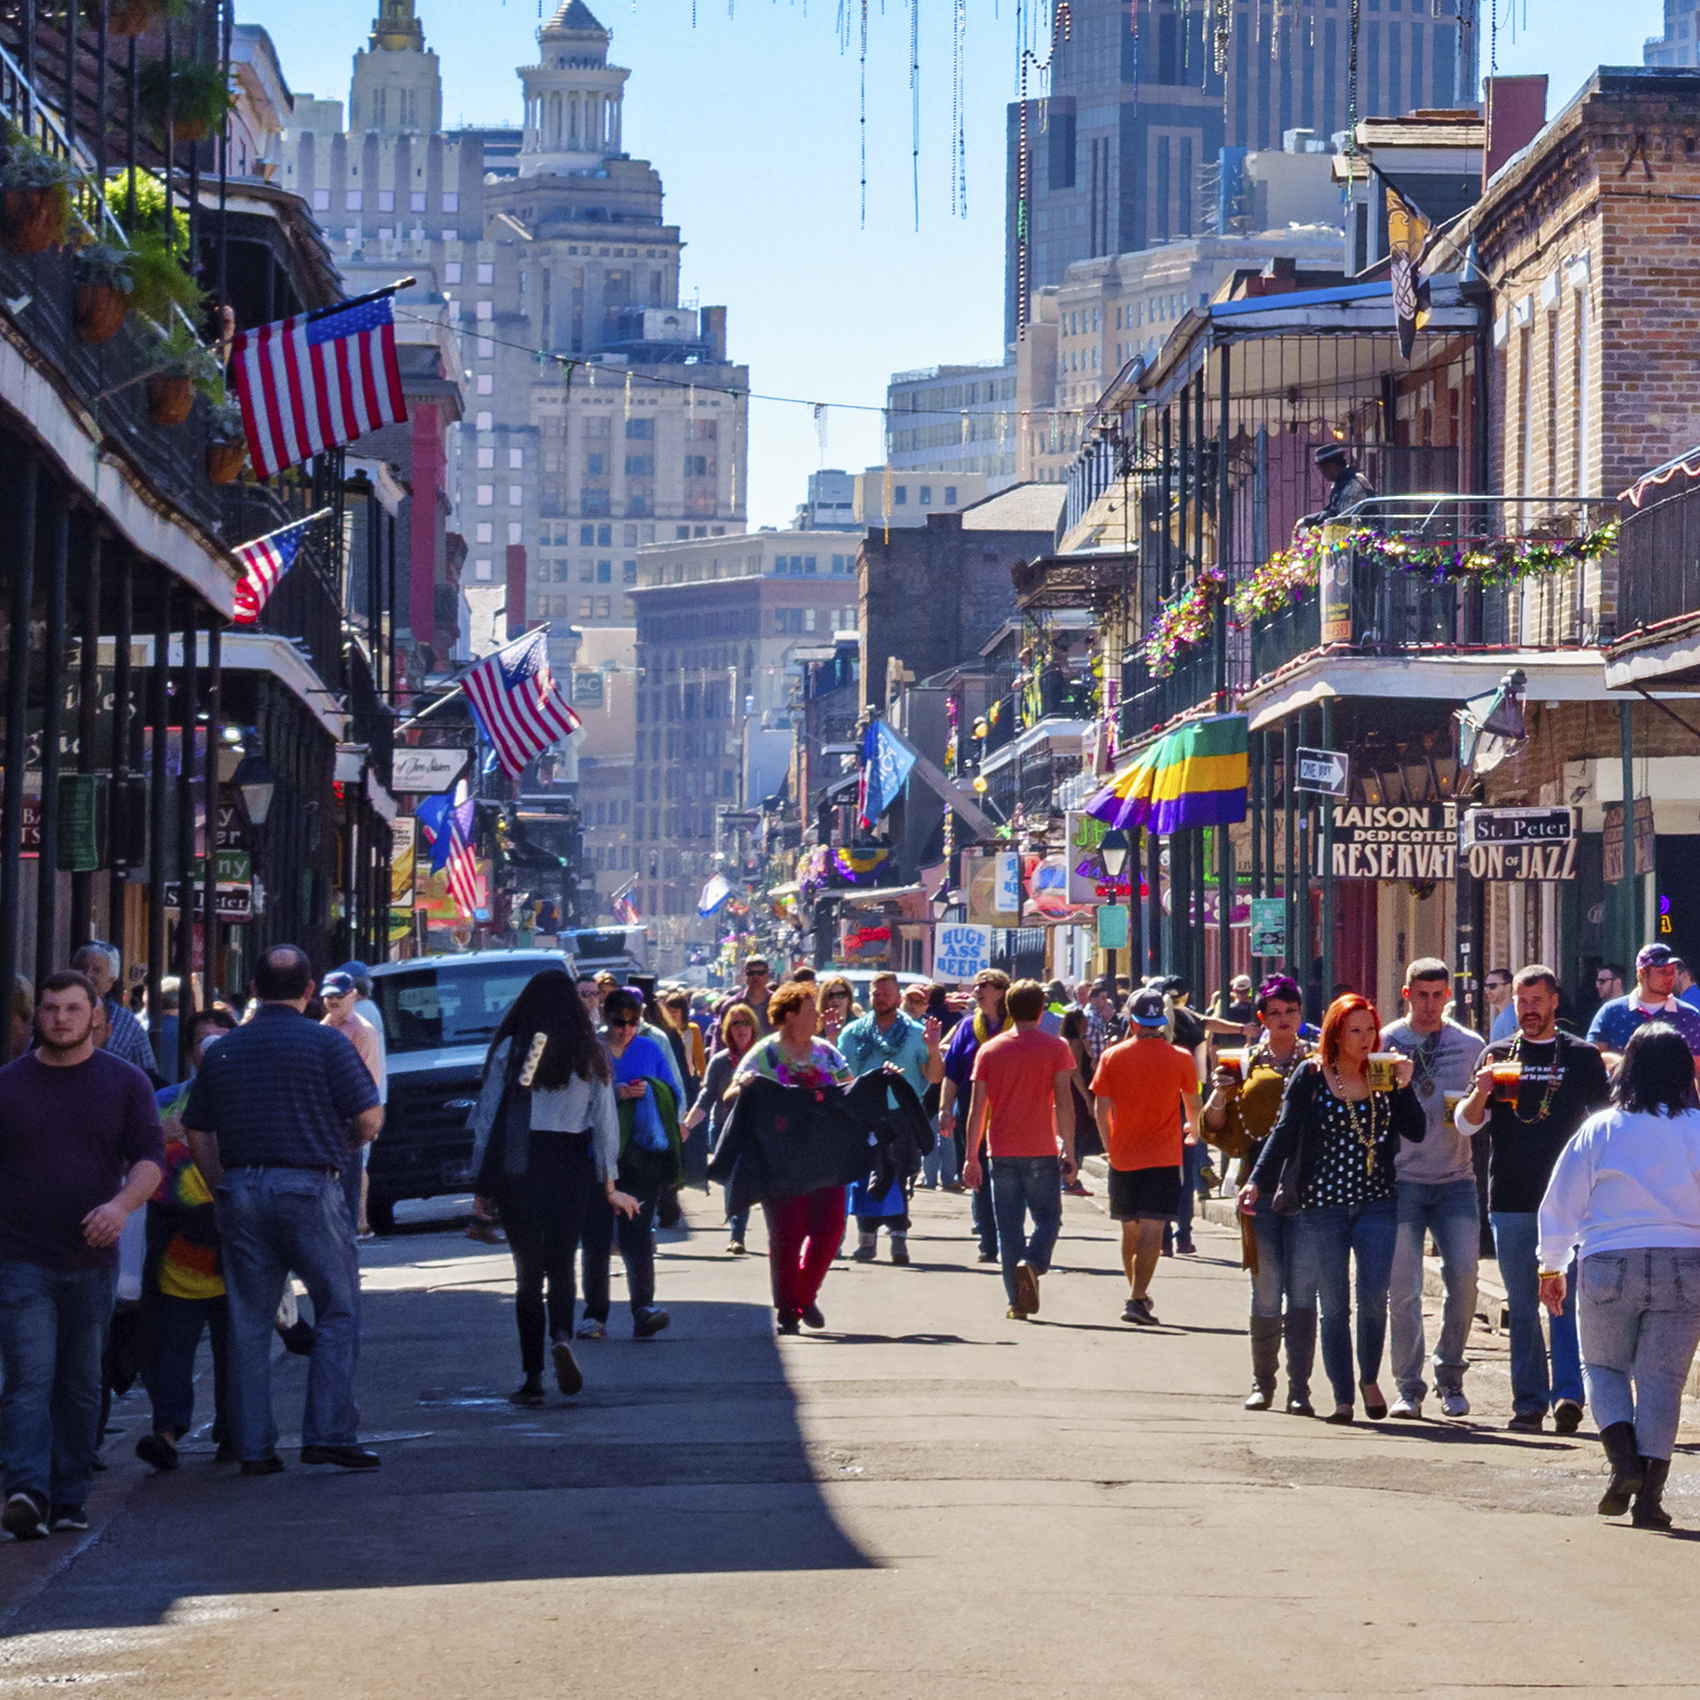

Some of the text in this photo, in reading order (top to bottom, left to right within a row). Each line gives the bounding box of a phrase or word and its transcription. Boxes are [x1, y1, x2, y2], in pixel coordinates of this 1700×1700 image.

[1354, 830, 1457, 843] DEDICATED
[1477, 820, 1567, 838] St. Peter
[1505, 839, 1579, 880] OF JAZZ
[942, 927, 986, 948] HUGE
[945, 945, 980, 958] ASS
[937, 957, 989, 979] BEERS
